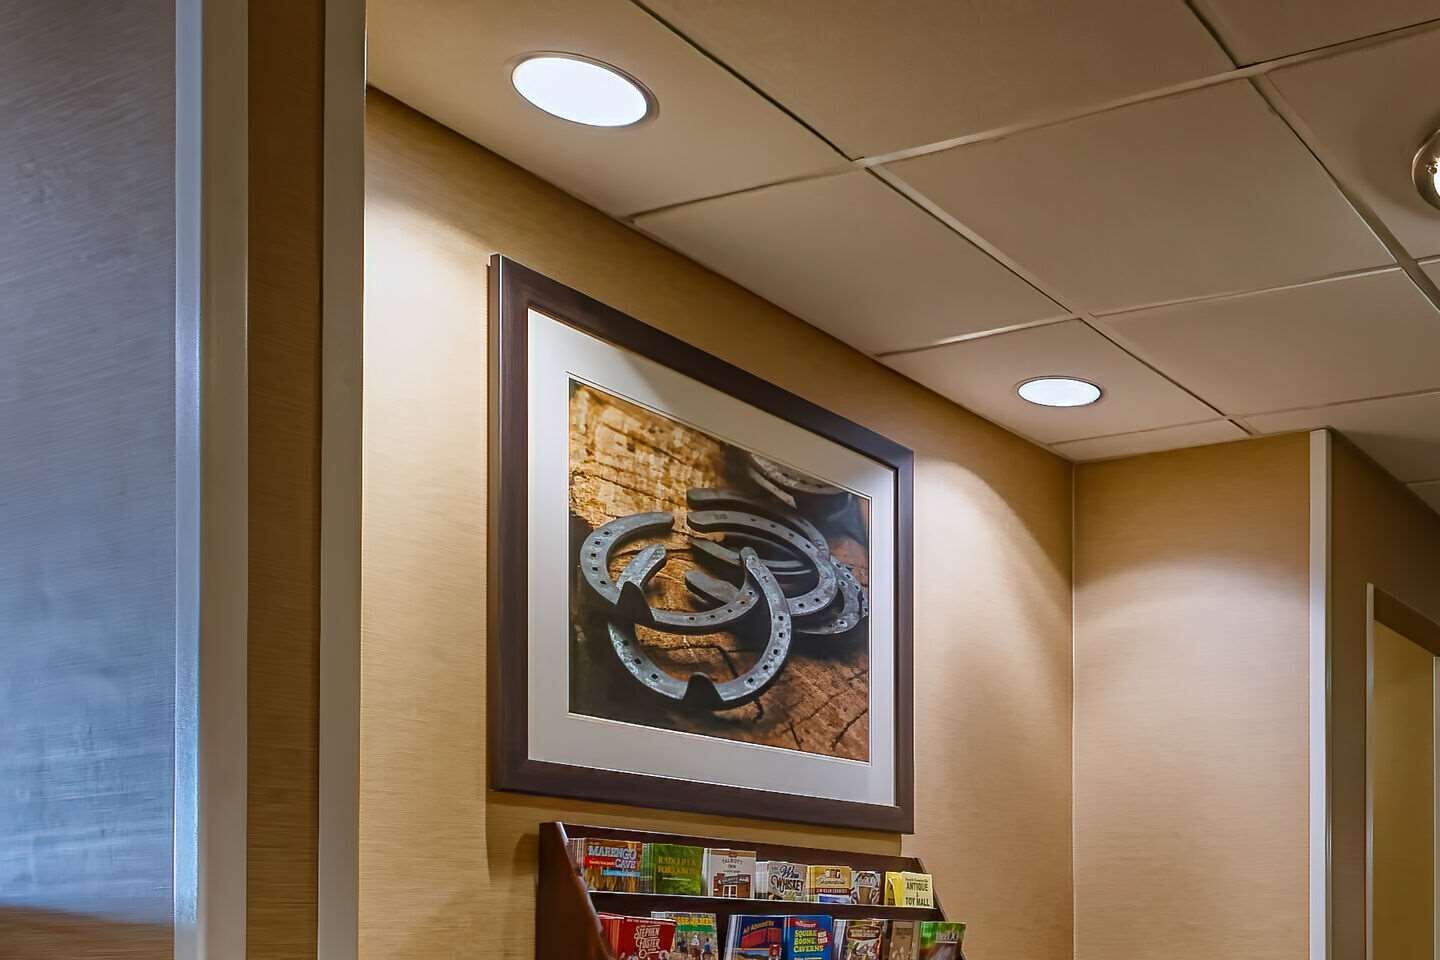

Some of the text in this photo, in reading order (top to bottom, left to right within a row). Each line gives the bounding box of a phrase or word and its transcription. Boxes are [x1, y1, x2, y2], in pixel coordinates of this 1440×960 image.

[615, 859, 636, 869] CAVE
[906, 881, 929, 892] ANTIQUE
[905, 897, 930, 907] TOY MALL
[634, 925, 660, 940] STEPHEN
[793, 945, 824, 953] CAVERNS
